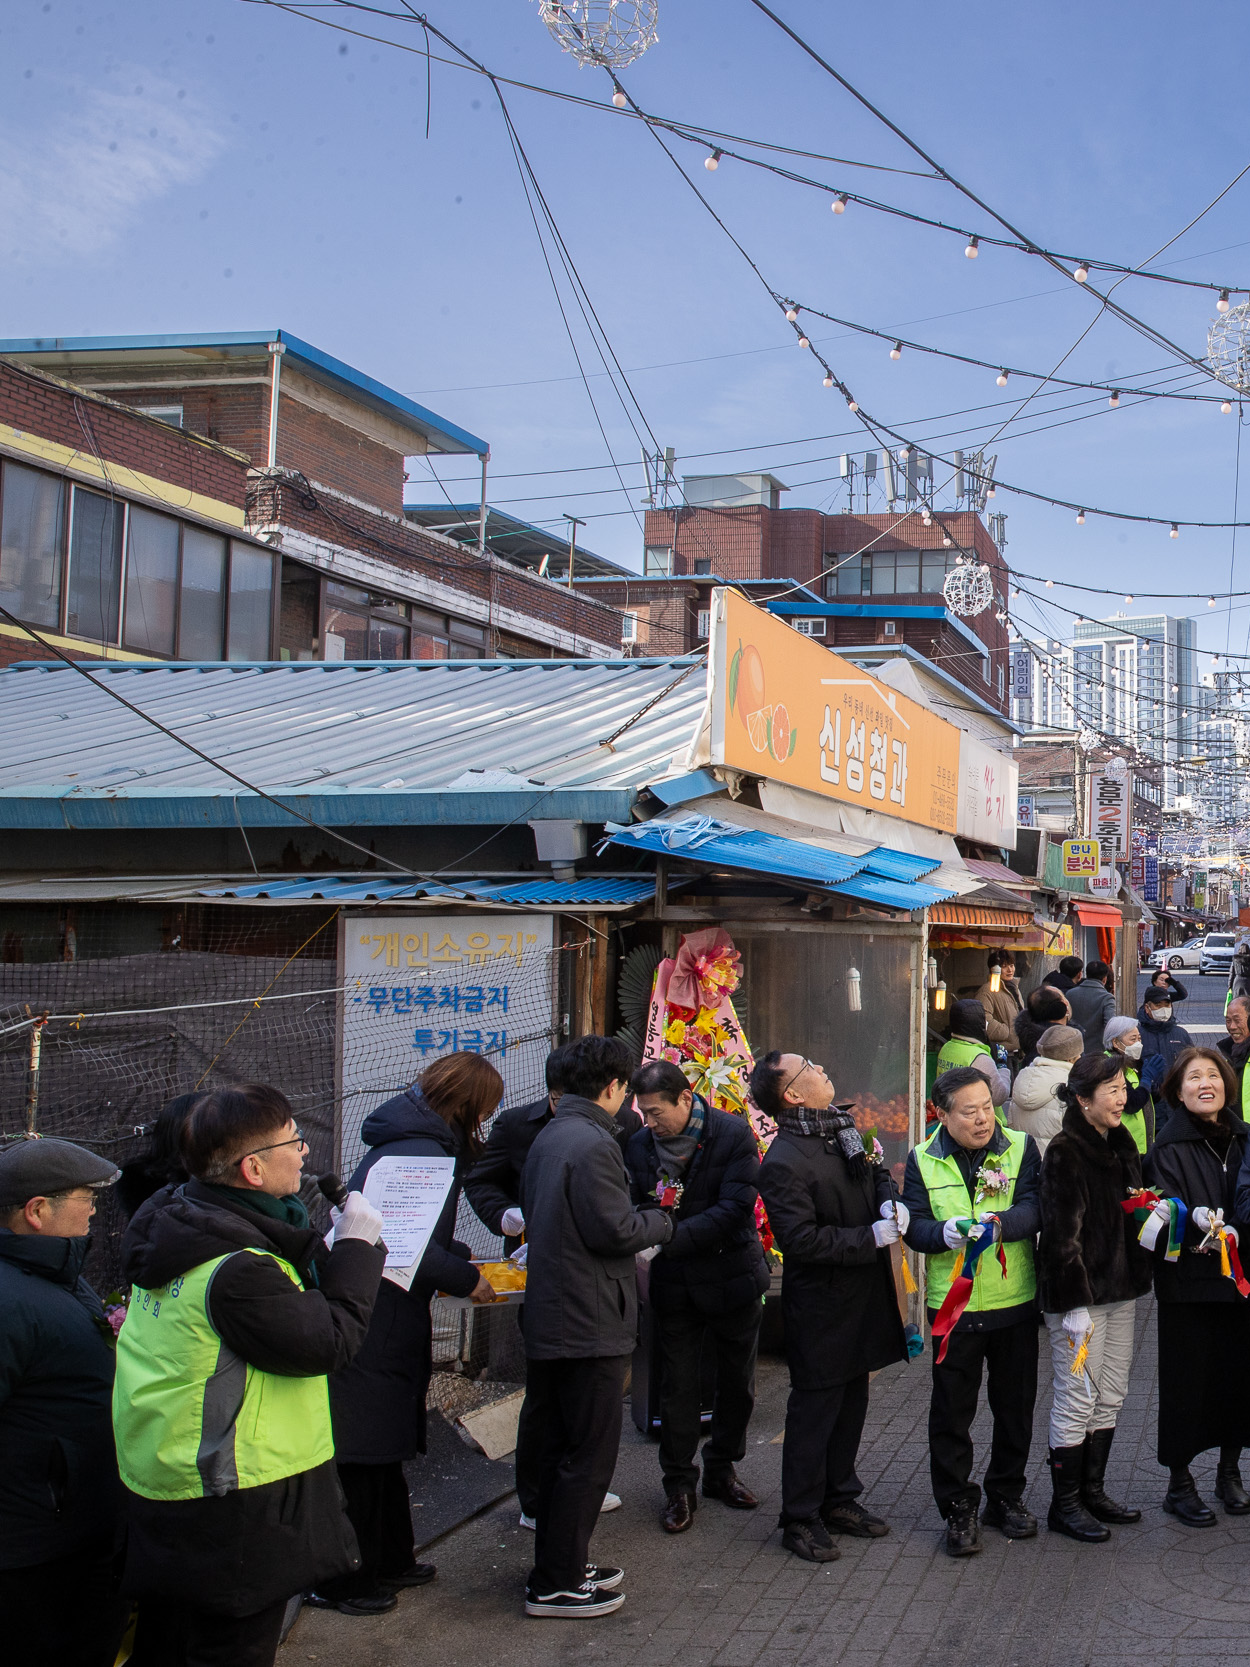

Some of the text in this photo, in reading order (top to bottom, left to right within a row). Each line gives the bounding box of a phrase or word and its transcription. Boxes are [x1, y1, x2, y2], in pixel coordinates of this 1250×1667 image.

[1017, 659, 1028, 694] 어린이집
[819, 704, 908, 808] 신성청과
[1018, 806, 1030, 827] 유
[1071, 845, 1091, 855] 만나
[1067, 856, 1095, 872] 분식
[412, 1029, 507, 1057] 투기금지
